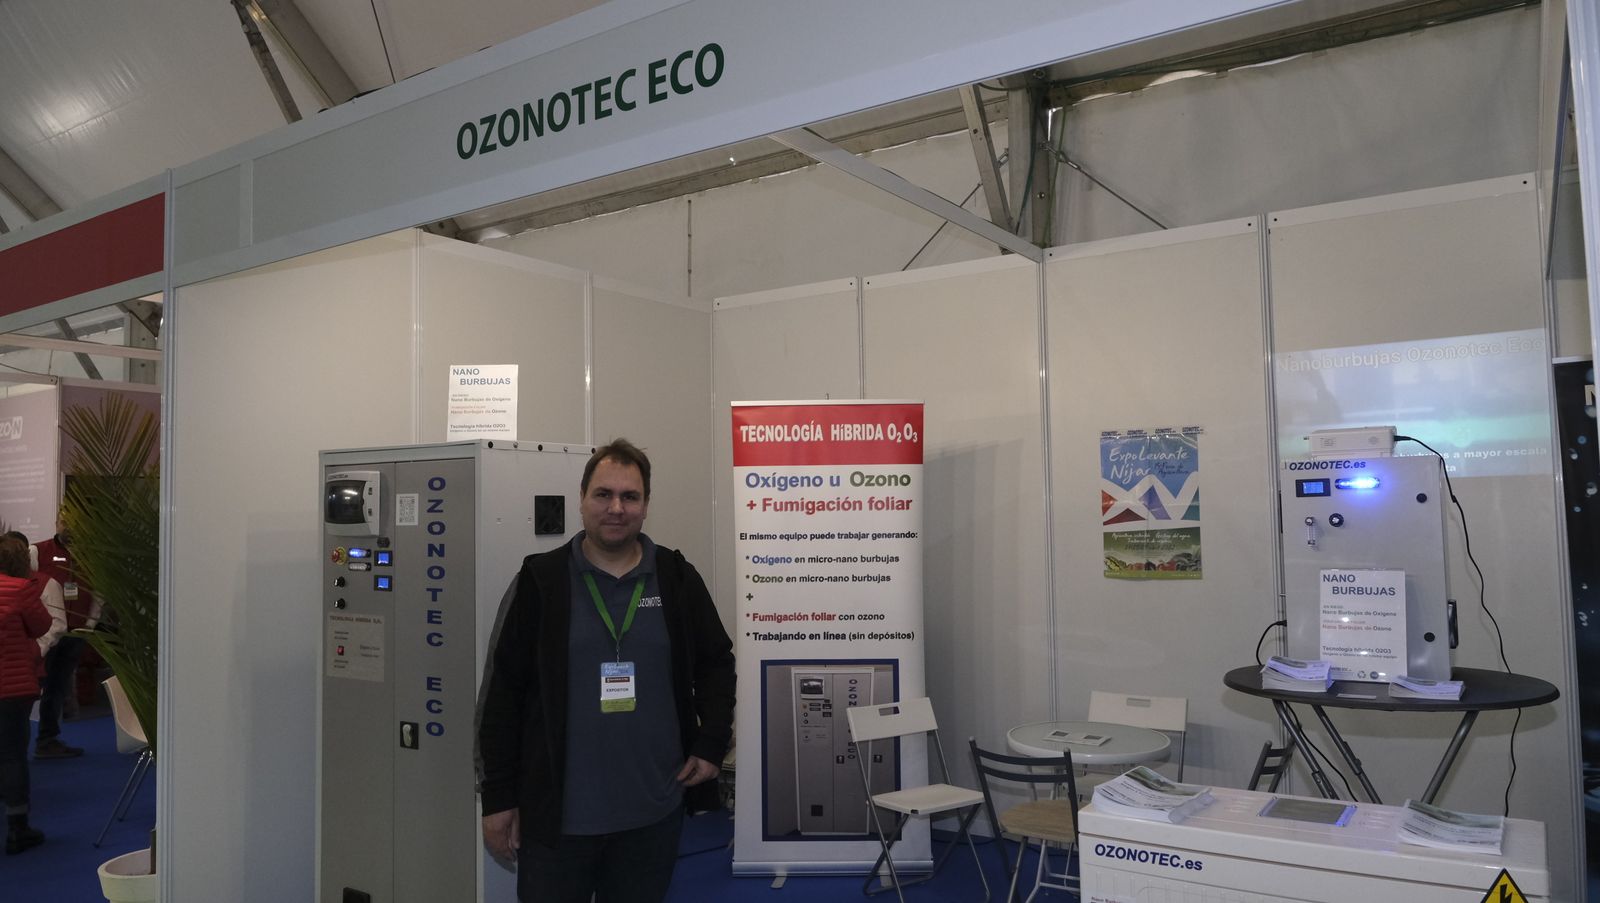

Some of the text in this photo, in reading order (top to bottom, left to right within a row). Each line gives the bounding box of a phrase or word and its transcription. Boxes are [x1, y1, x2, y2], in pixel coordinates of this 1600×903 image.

[457, 42, 725, 160] OZONOTEC ECO
[1407, 343, 1501, 361] Ozonotec
[452, 368, 480, 376] NANO
[460, 378, 511, 386] BURBUJAS
[740, 420, 824, 442] TECNOLOGÍA
[1464, 450, 1501, 459] mayor
[1505, 448, 1547, 457] escala
[1289, 460, 1366, 471] OZONOTEC.es
[745, 471, 912, 491] Oxígeno u Ozono
[762, 496, 863, 515] Fumigación
[867, 496, 913, 511] foliar
[739, 530, 919, 542] El mismo equipo puede trabajar generando:
[752, 555, 793, 566] Oxígeno
[807, 555, 859, 563] micro-nano
[860, 554, 900, 565] burbujas
[752, 574, 784, 583] Ozono
[799, 574, 850, 583] micro-nano
[851, 574, 891, 584] burbujas
[1323, 574, 1356, 583] NANO
[1332, 586, 1396, 596] BURBUJAS
[425, 476, 446, 737] OZONOTEC ECO
[752, 612, 885, 623] Fumigación foliar con ozono
[752, 631, 915, 643] Trabajando en línea (sin depósitos)
[1094, 843, 1203, 871] OZONOTEC.es
